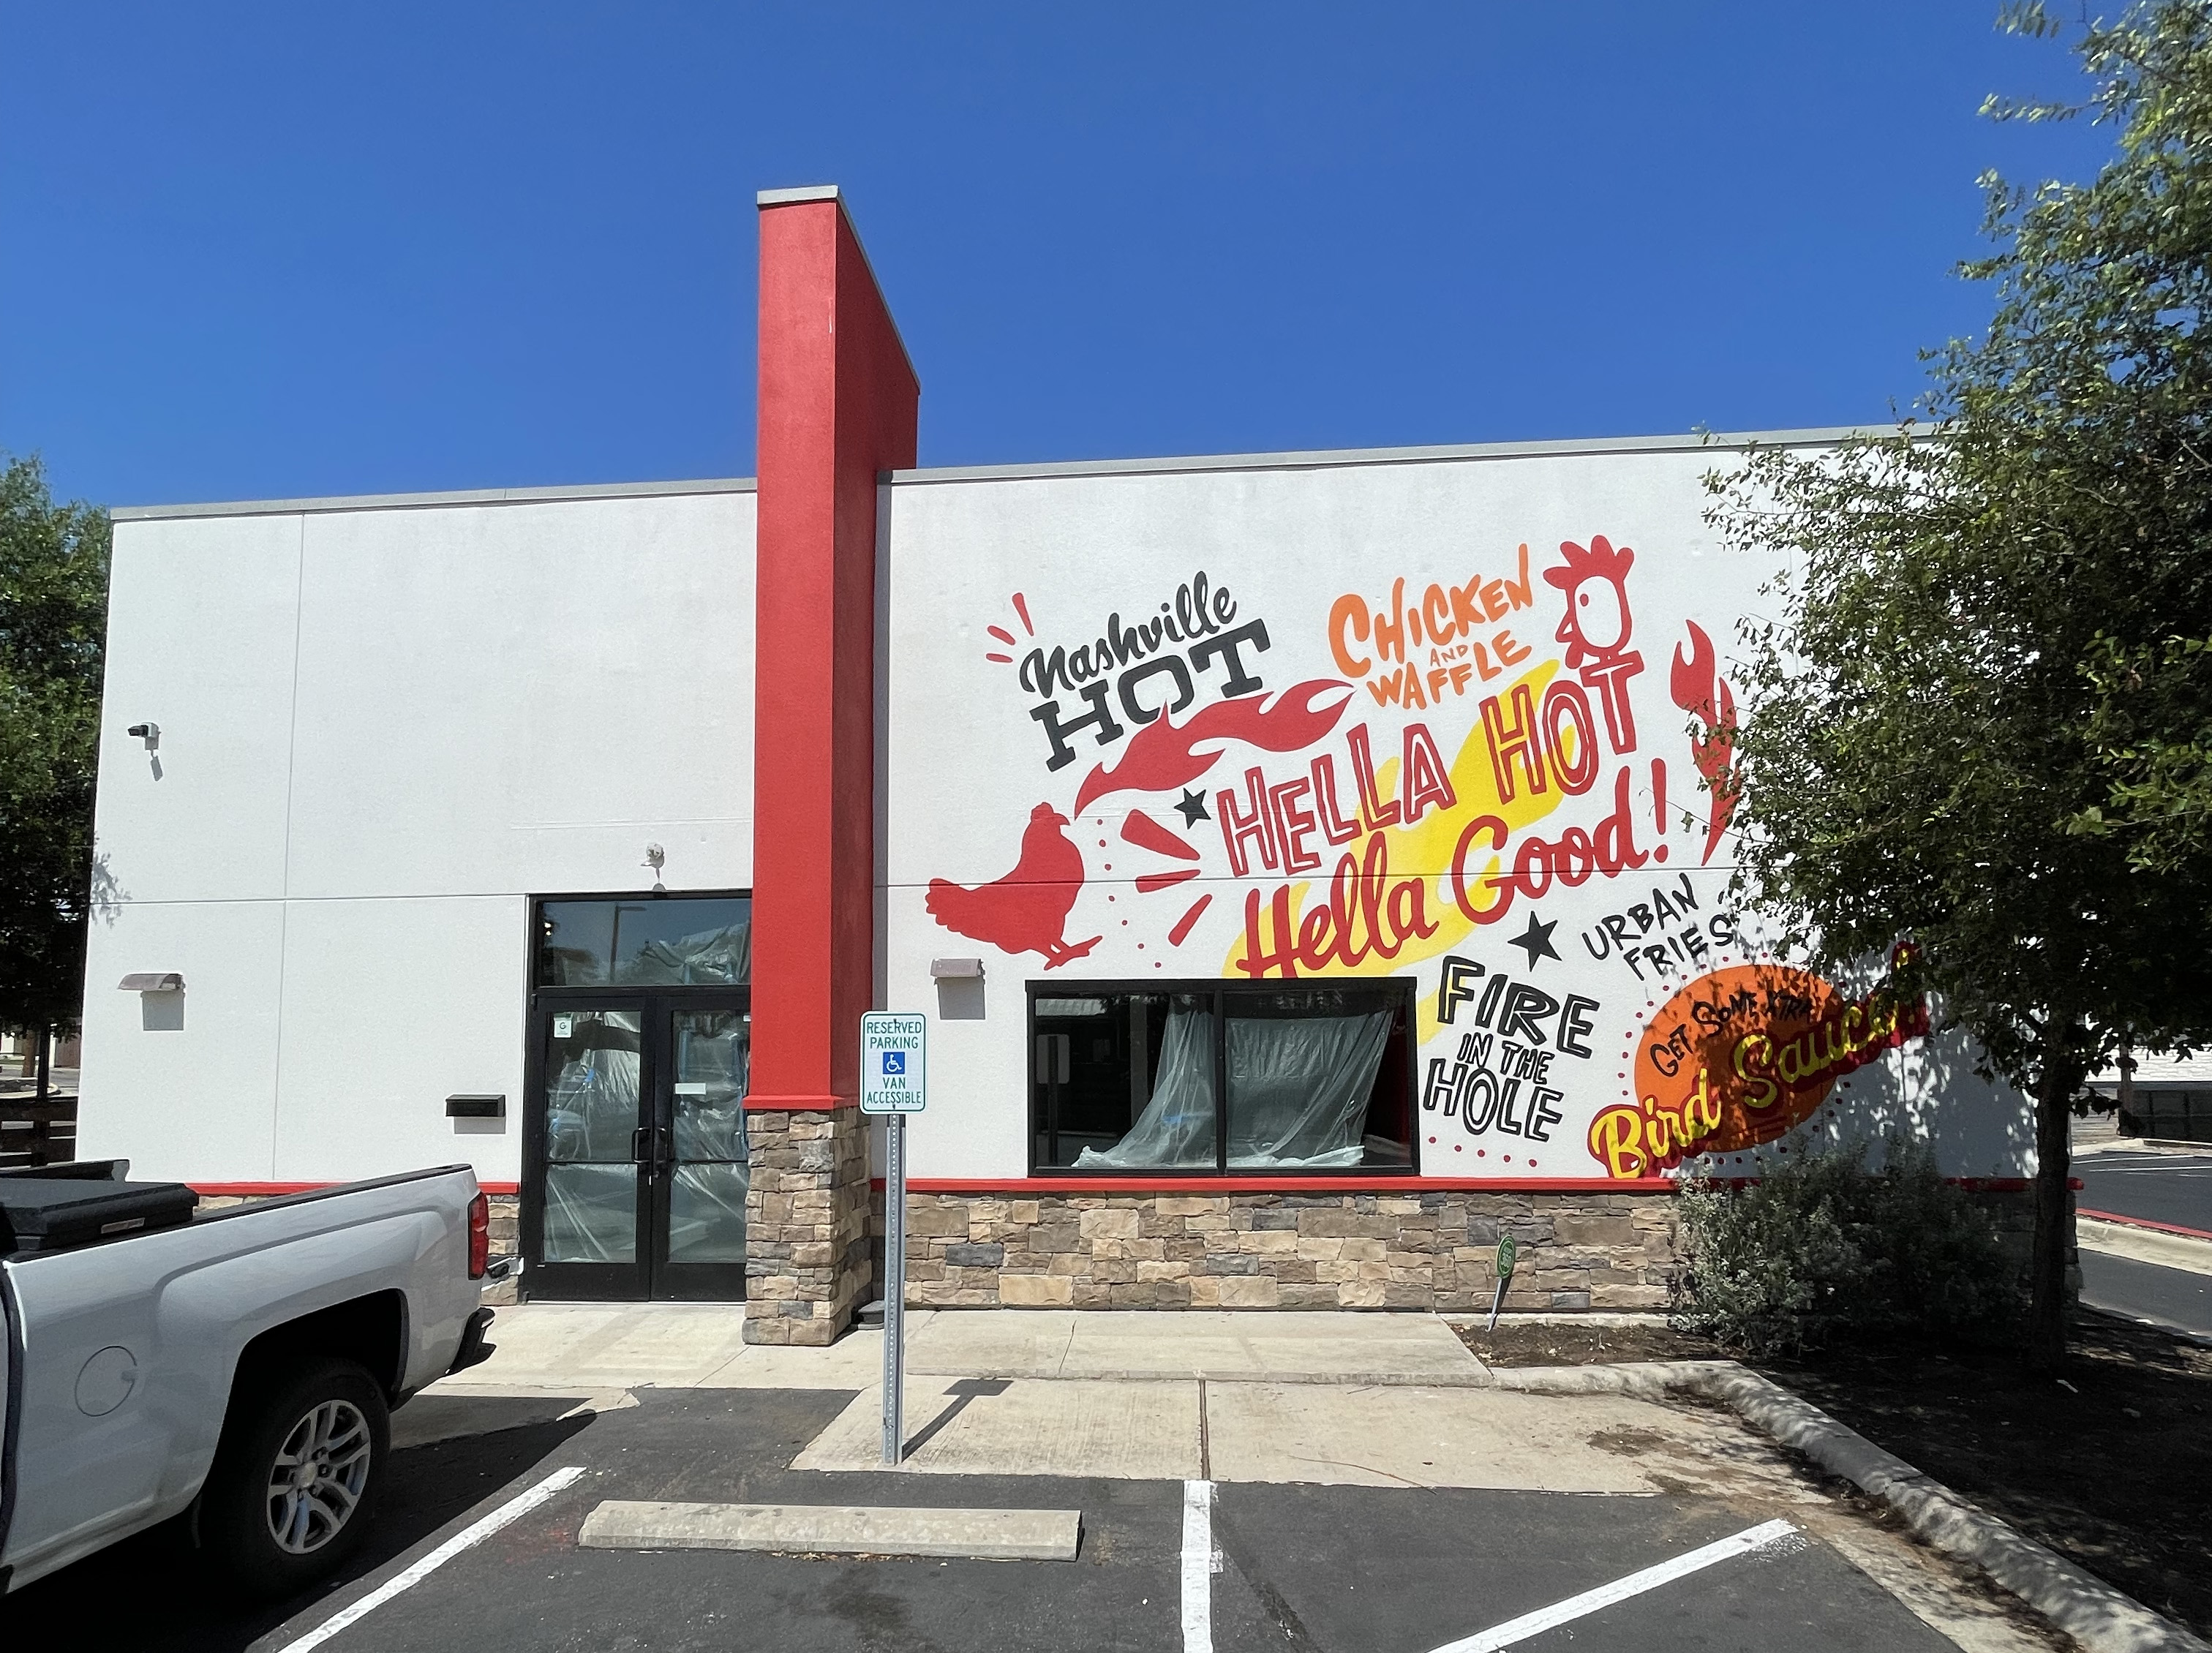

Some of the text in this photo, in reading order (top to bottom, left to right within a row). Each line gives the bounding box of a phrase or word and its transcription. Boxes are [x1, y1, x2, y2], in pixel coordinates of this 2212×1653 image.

[1019, 571, 1237, 699] Nashville
[1328, 543, 1532, 678] CHICKEN
[1030, 617, 1271, 772] HOT
[1367, 630, 1532, 709] WAFFLE
[1429, 644, 1469, 667] AND
[1216, 649, 1644, 877] HELLA HOT
[1235, 758, 1669, 978] Hella Good!
[1581, 873, 1699, 960] URBAN
[1623, 914, 1734, 981] FRIES
[867, 1021, 922, 1034] RESERVED
[870, 1036, 919, 1049] PARKING
[1437, 955, 1600, 1059] FIRE
[883, 1077, 906, 1089] VAN
[1457, 1032, 1556, 1084] IN THE
[1649, 1024, 1694, 1077] GET
[867, 1091, 922, 1104] ACCESSIBLE
[1423, 1058, 1564, 1142] HOLE
[1591, 1068, 1721, 1178] Bird
